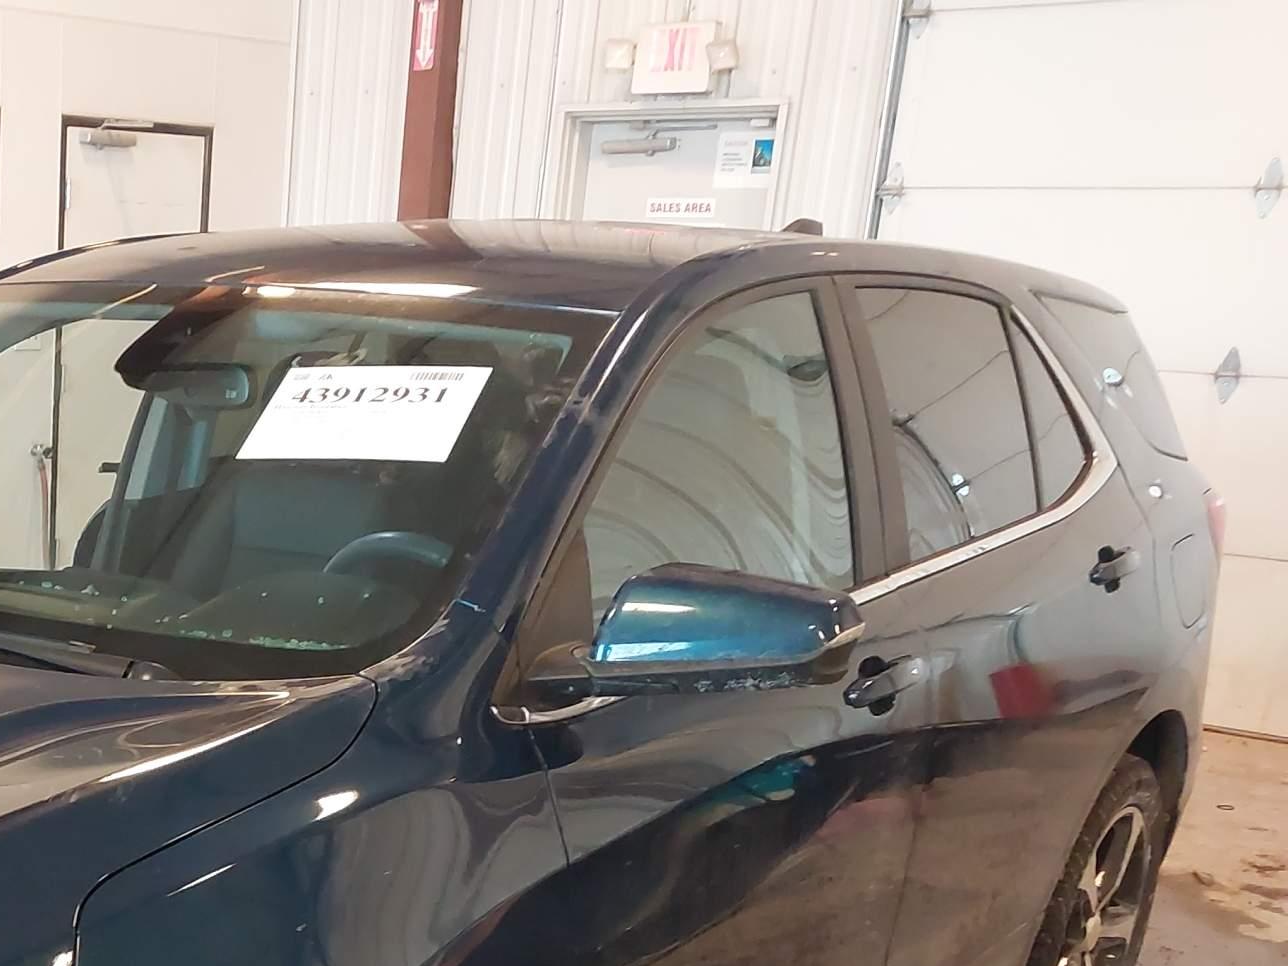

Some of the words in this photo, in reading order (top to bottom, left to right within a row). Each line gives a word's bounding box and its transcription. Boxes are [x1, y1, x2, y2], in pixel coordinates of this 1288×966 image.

[649, 202, 681, 213] SALES
[684, 202, 711, 213] AREA
[291, 386, 449, 403] 43912931
